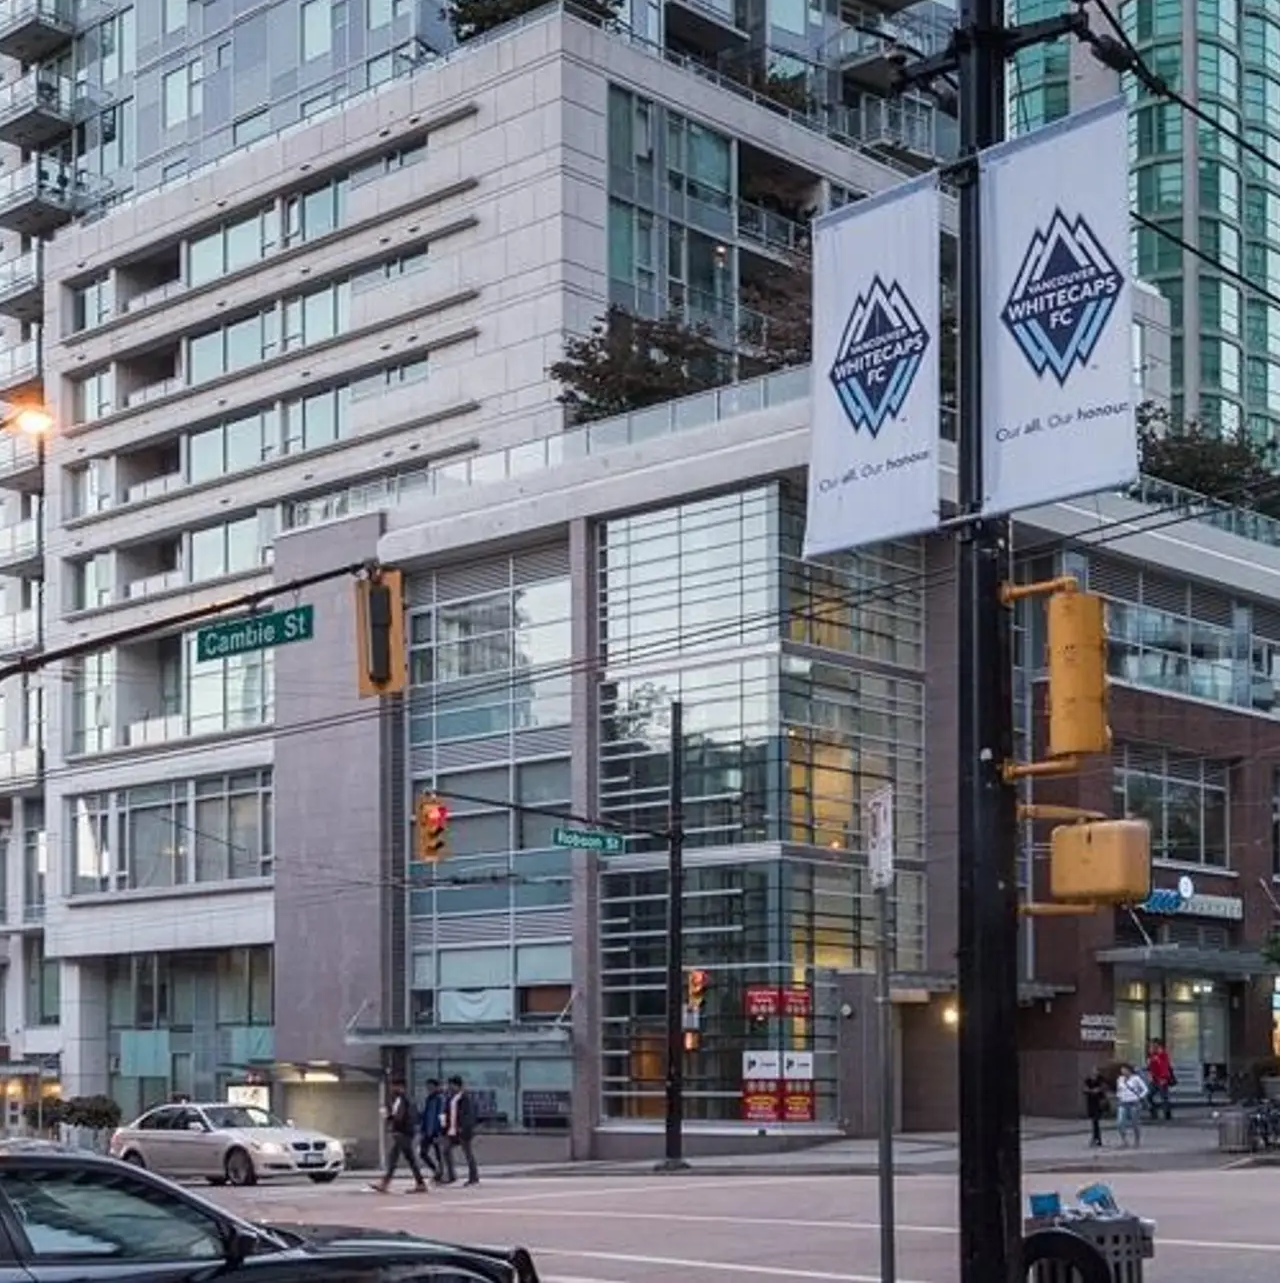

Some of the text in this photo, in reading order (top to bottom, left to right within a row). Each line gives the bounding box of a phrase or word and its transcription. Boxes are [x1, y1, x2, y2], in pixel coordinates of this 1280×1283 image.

[1008, 274, 1118, 322] WHITECAPS
[1048, 308, 1074, 330] FC
[834, 333, 924, 380] WHITECAPS
[867, 366, 886, 387] FC
[996, 427, 1021, 442] Our
[1047, 414, 1073, 429] Our
[204, 613, 307, 656] Cambie St
